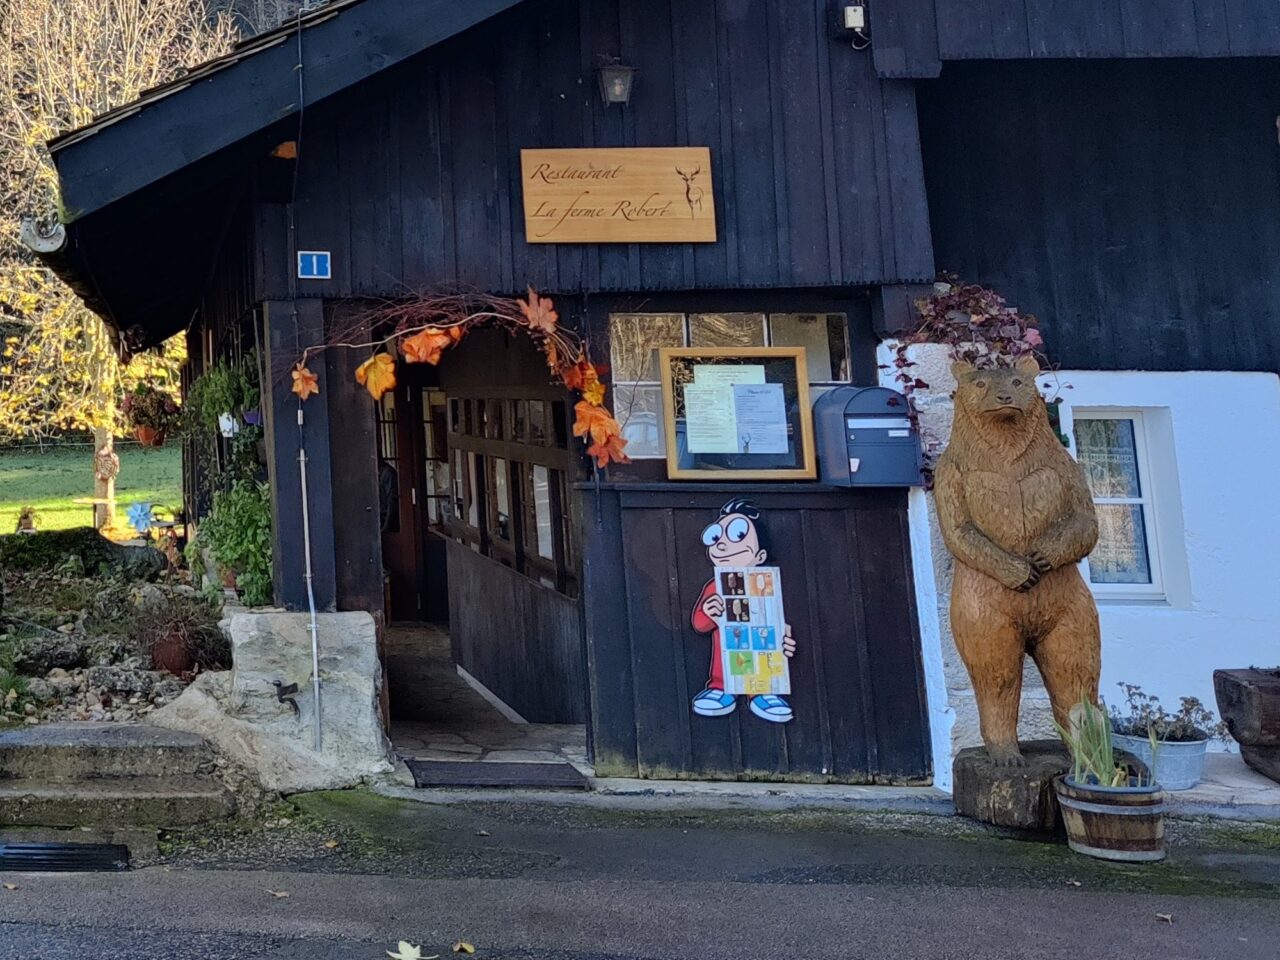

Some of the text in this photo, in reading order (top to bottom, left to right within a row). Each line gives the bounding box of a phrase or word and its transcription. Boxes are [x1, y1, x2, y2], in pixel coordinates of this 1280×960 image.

[530, 162, 624, 184] Restaurant
[531, 191, 673, 237] La ferme Robert
[311, 254, 318, 275] 1
